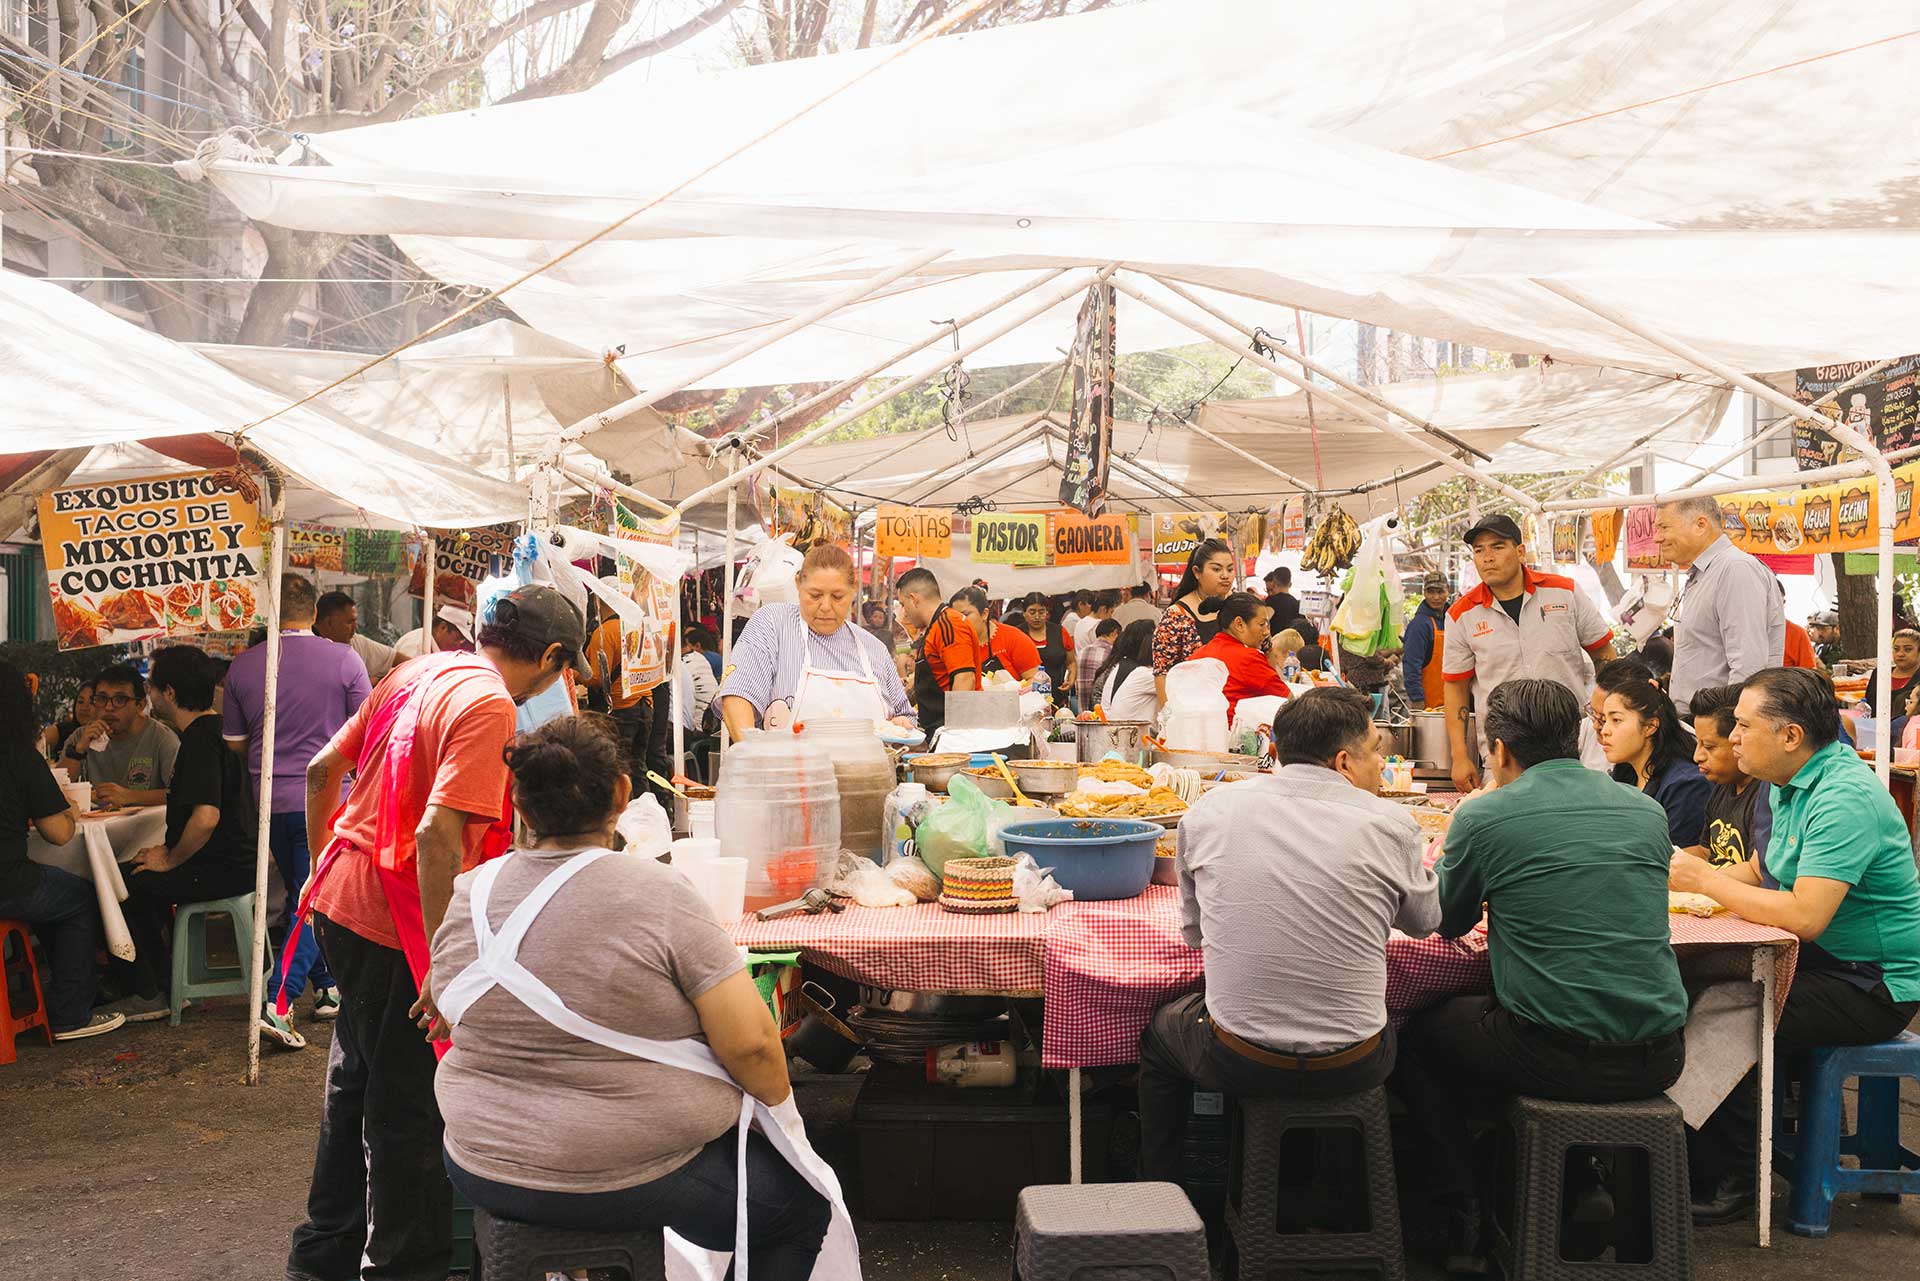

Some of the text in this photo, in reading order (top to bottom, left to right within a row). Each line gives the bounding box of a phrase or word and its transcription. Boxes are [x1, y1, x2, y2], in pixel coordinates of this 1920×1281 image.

[54, 476, 237, 512] EXQUISITO
[75, 503, 229, 535] TACOS DE
[880, 514, 950, 538] TORTAS
[1803, 507, 1831, 529] AGUJA
[64, 524, 244, 567] MIXIOTE Y
[290, 530, 341, 545] TACOS
[976, 522, 1039, 553] PASTOR
[1055, 525, 1124, 554] GAONERA
[435, 535, 514, 572] MIXIOE
[60, 553, 257, 596] COCHINITA
